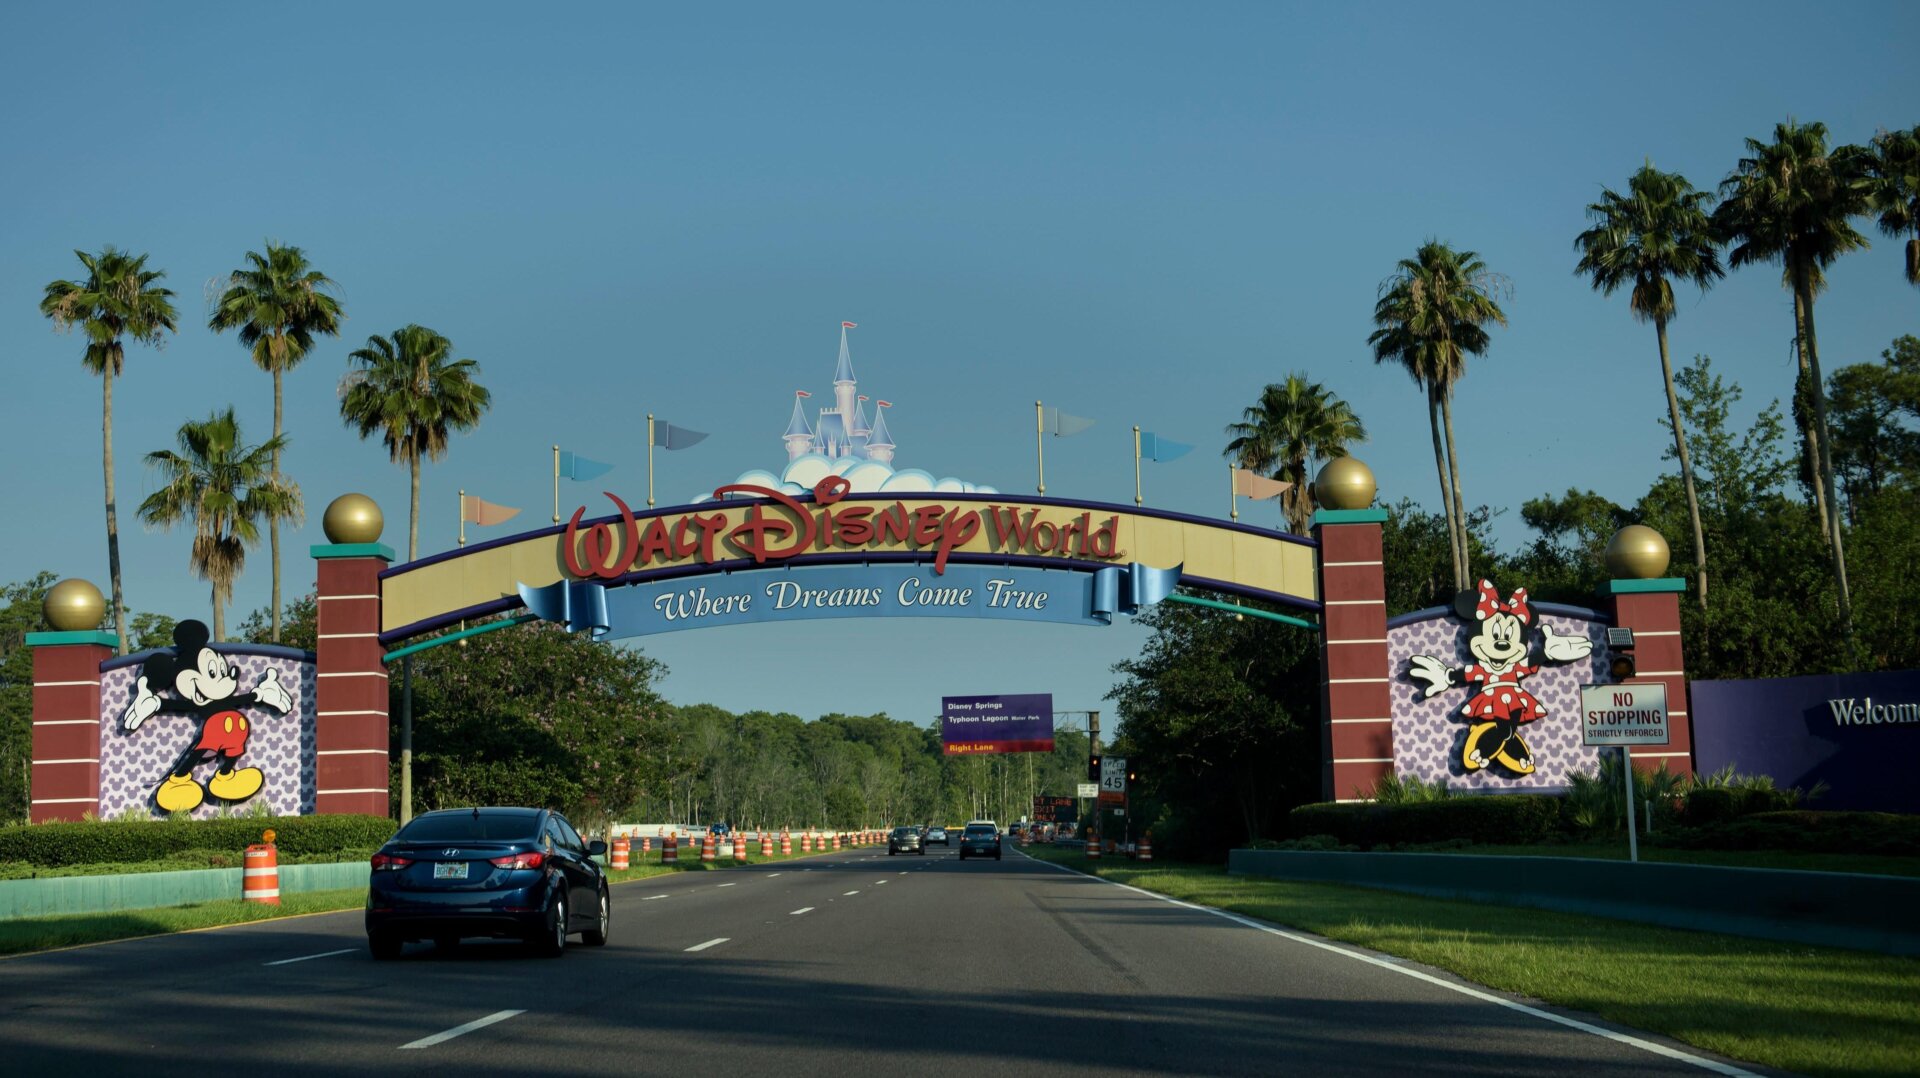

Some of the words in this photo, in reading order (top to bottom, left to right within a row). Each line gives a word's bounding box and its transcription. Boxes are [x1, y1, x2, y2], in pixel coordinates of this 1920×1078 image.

[654, 587, 752, 621] Where
[765, 580, 882, 610] Dreams
[898, 577, 973, 607] Come
[986, 578, 1048, 610] True
[1613, 692, 1633, 707] NO
[947, 703, 973, 711] Disney
[975, 702, 1003, 710] Springs
[1828, 697, 1920, 726] Welcom
[948, 716, 980, 724] Typhoon
[982, 715, 1009, 723] Lagoon
[1588, 709, 1662, 726] STOPPING
[1588, 729, 1622, 738] STRICTLY
[1624, 728, 1664, 737] ENFORCED
[949, 744, 971, 752] Right
[974, 743, 994, 751] Lane
[1104, 777, 1122, 789] 45
